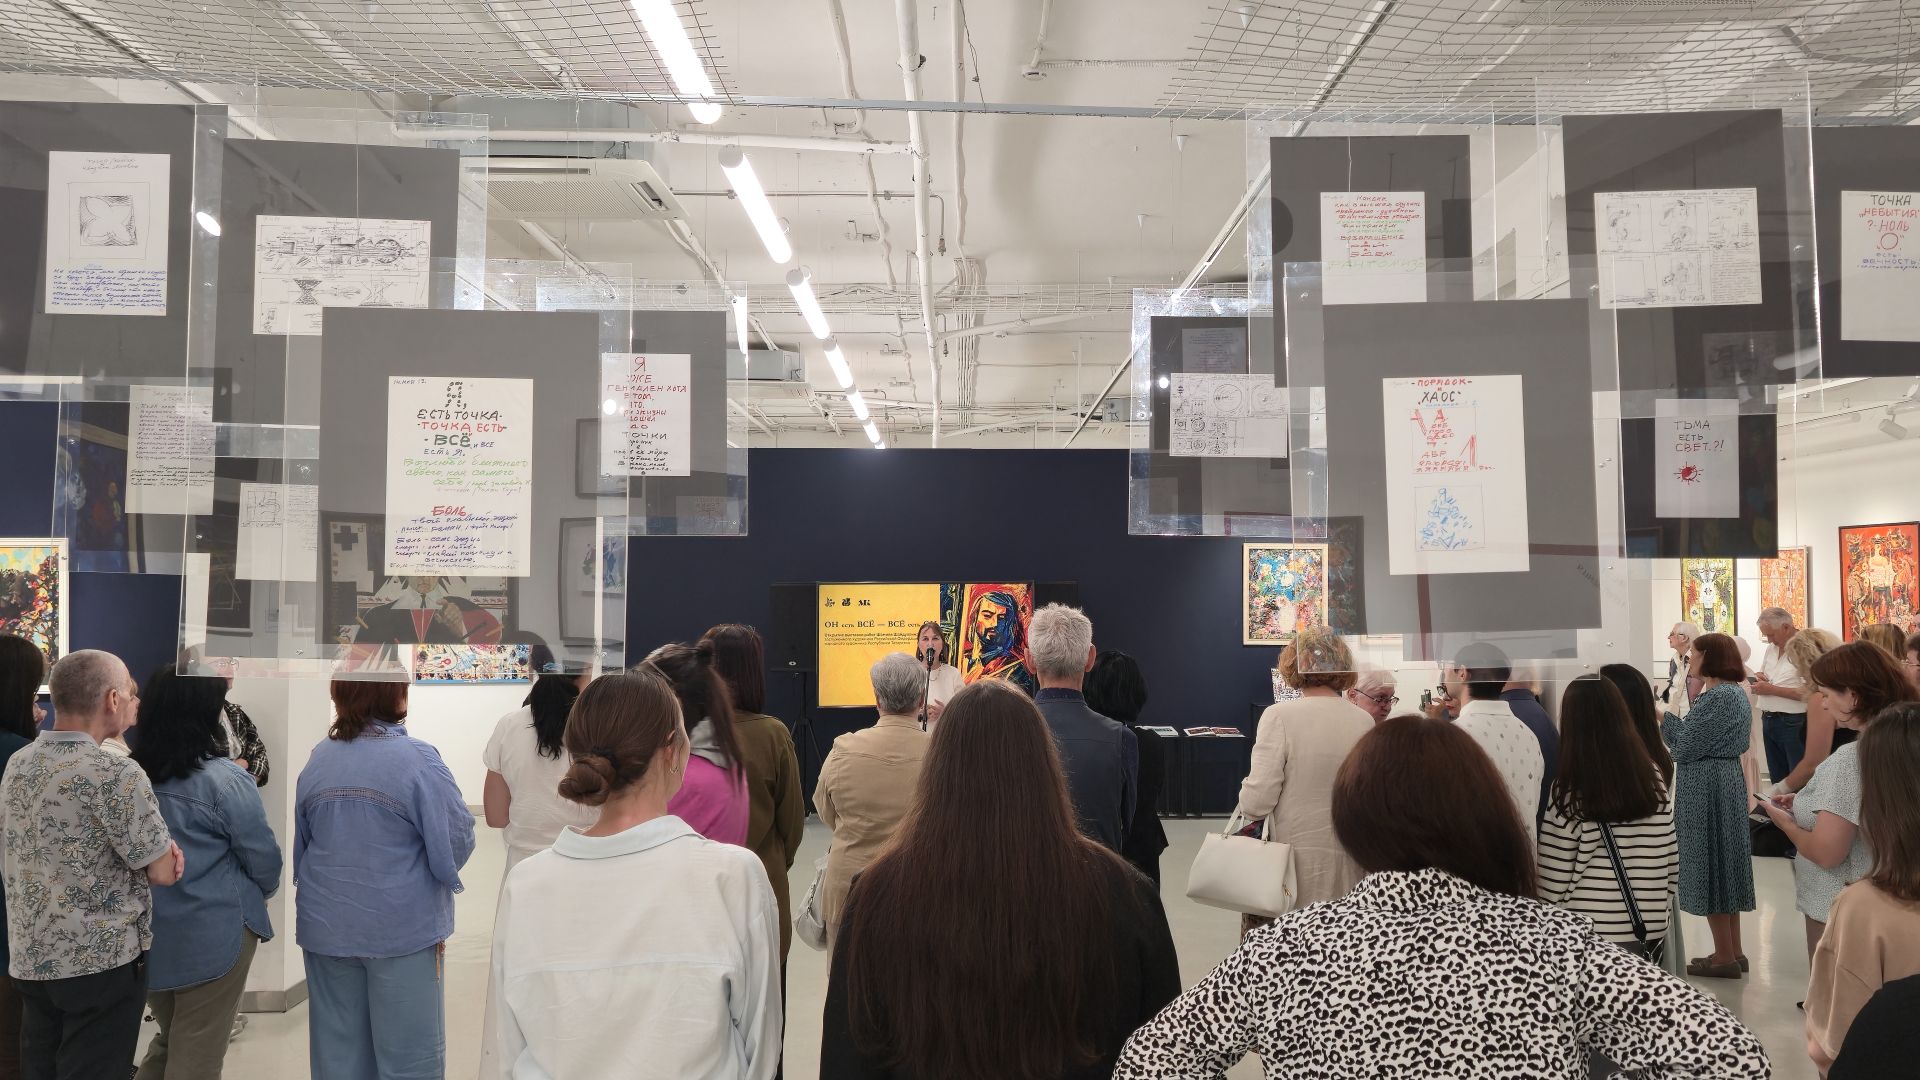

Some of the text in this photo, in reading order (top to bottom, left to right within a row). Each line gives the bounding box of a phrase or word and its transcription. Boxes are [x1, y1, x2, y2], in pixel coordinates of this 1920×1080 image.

[1871, 194, 1912, 206] ТОЧКА
[634, 356, 646, 372] Я
[417, 409, 450, 420] ЕСТЬ
[1674, 420, 1711, 430] ТЬМА
[622, 432, 668, 440] ТОЧКИ
[858, 620, 874, 628] ВСЁ
[888, 620, 905, 628] ВСЁ
